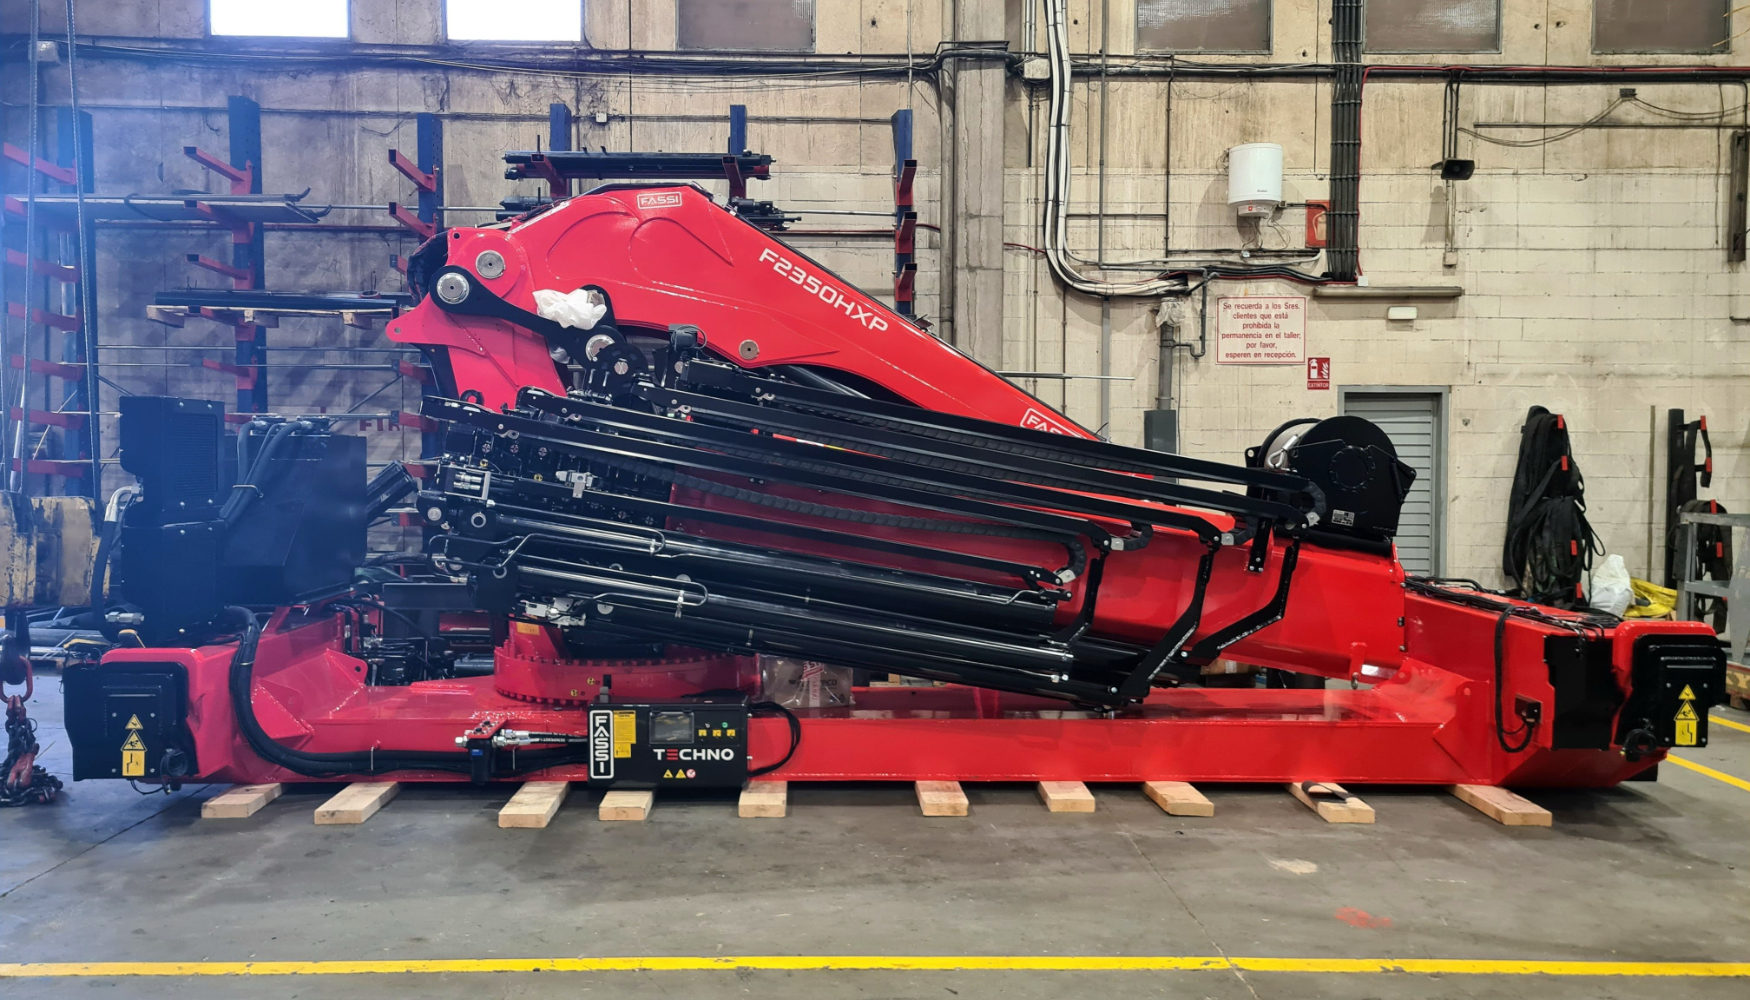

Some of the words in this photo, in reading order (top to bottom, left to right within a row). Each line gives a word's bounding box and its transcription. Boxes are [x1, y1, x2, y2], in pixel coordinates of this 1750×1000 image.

[641, 194, 679, 205] FASSI
[759, 247, 889, 332] F2350HXP
[1223, 302, 1232, 310] Se
[1234, 302, 1263, 310] recuerda
[1272, 302, 1281, 310] los
[1284, 302, 1300, 310] Sres.
[1233, 312, 1257, 320] clientes
[1260, 313, 1272, 321] que
[1274, 312, 1289, 320] está
[1242, 322, 1272, 330] prohibida
[1222, 332, 1262, 340] permanencia
[1260, 342, 1278, 350] favor,
[593, 715, 610, 774] FASSI
[653, 748, 735, 761] TECHNO
